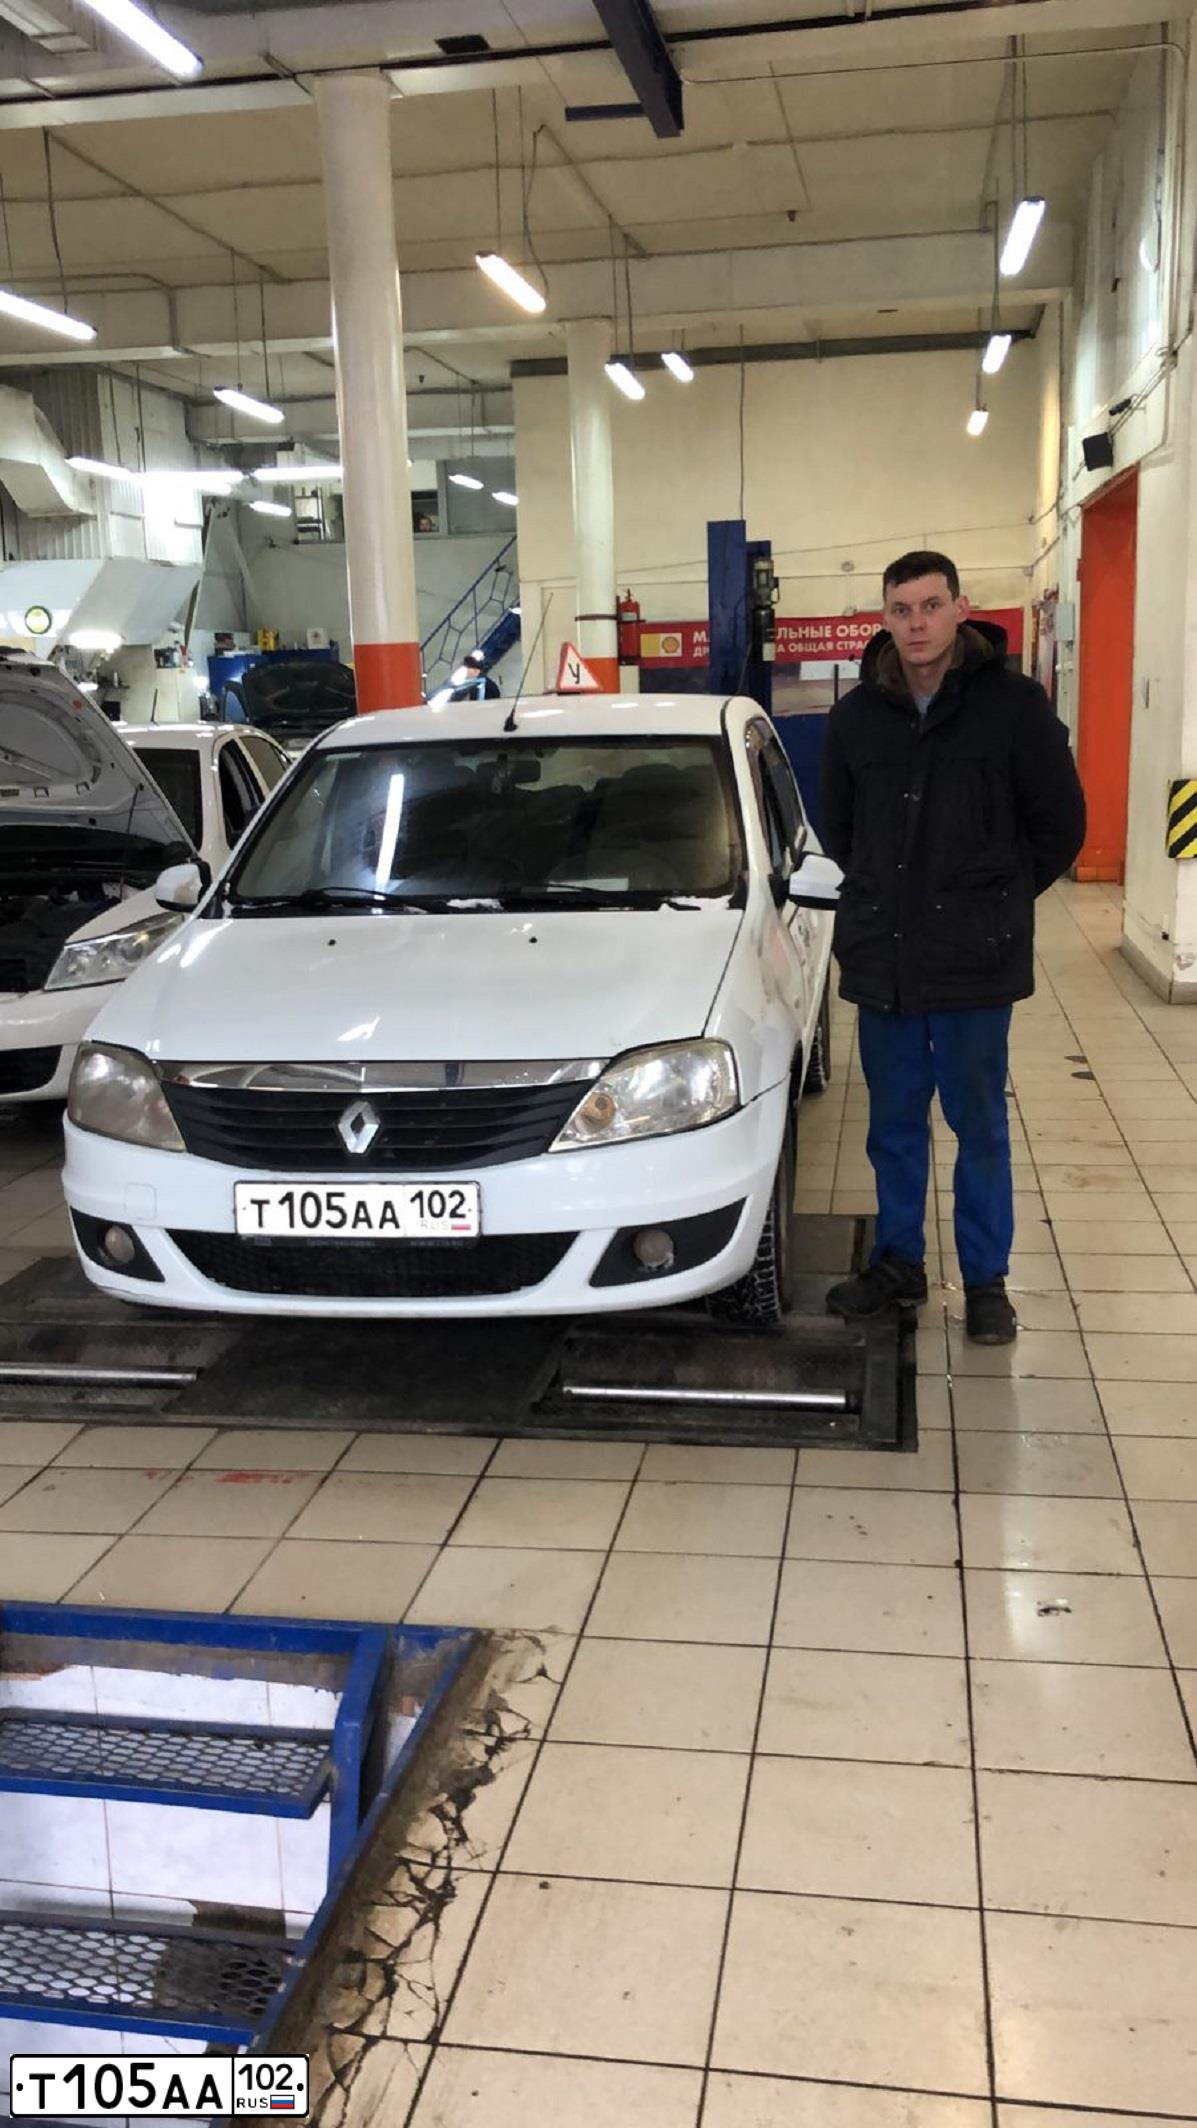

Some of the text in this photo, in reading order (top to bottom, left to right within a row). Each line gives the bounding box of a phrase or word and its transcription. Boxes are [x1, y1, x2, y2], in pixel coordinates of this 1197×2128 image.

[836, 624, 882, 637] ОБОР
[788, 642, 833, 653] ОБЩАЯ
[836, 639, 870, 650] СТРА
[568, 663, 580, 684] У
[410, 1190, 466, 1218] 102
